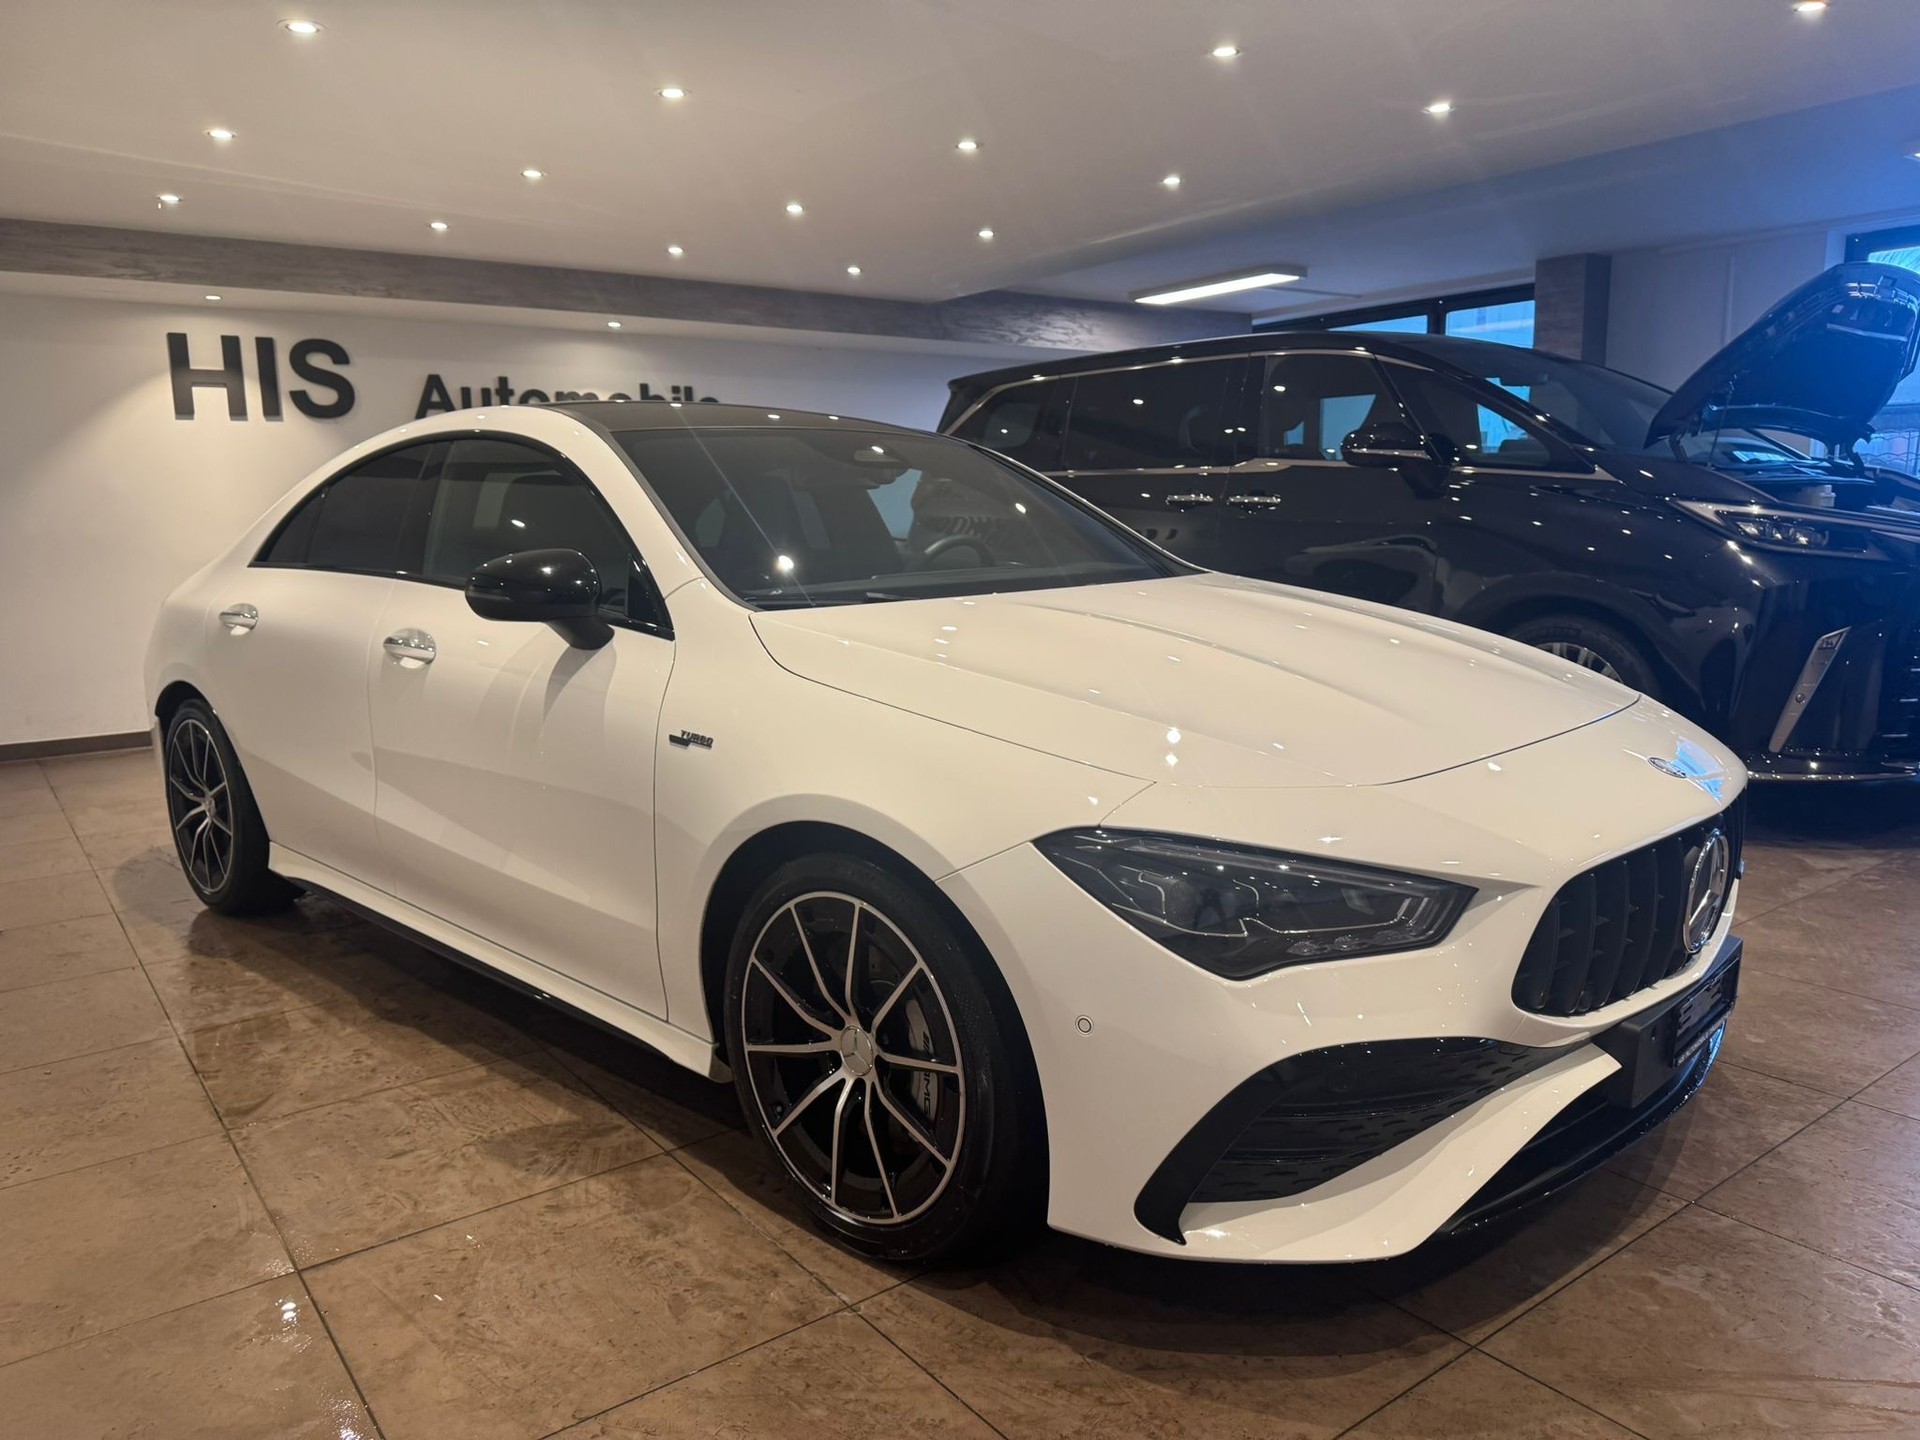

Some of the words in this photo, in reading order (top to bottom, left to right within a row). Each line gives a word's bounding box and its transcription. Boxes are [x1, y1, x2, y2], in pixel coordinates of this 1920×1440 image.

[167, 332, 355, 421] HIS
[415, 373, 720, 419] Autobil
[681, 729, 713, 747] TURBO
